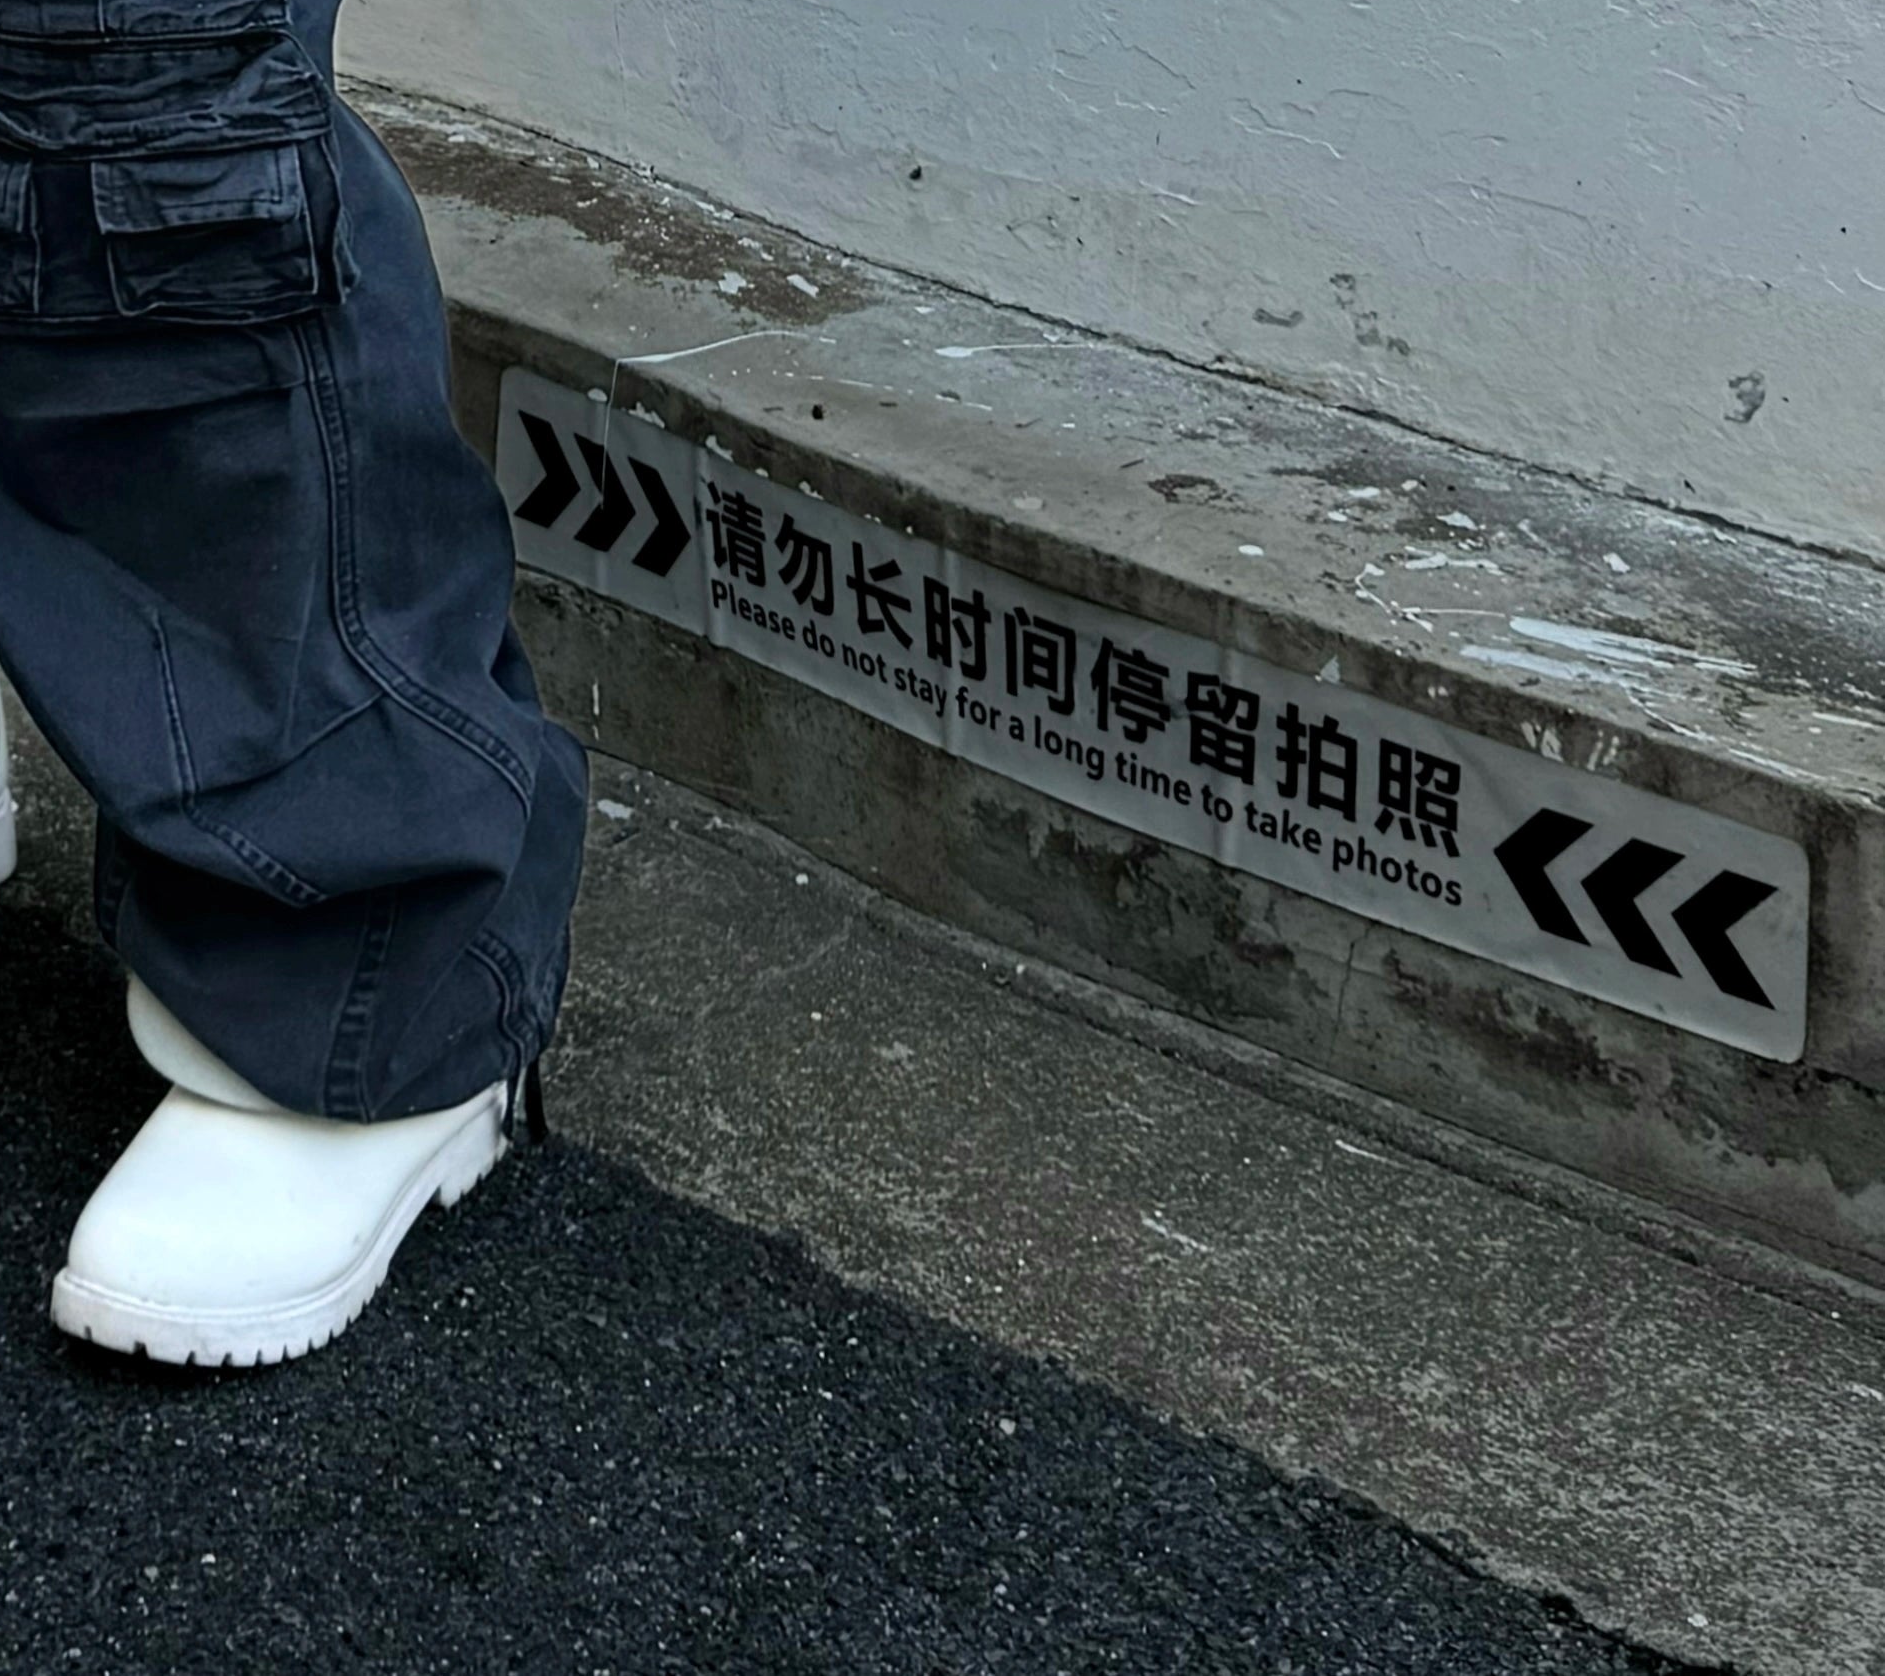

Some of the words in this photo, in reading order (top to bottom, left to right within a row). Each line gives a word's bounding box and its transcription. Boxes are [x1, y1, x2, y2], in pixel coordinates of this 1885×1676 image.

[706, 480, 1462, 858] 请勿长时间停留拍照
[711, 578, 796, 641] Please
[803, 620, 835, 659] do
[842, 642, 888, 684] not
[894, 667, 947, 718] stay
[955, 685, 1002, 731] for
[1009, 715, 1025, 742] a
[1034, 715, 1104, 781] long
[1115, 751, 1192, 806] time
[1201, 783, 1233, 823] to
[1245, 801, 1322, 855] take
[1332, 835, 1462, 907] photos
